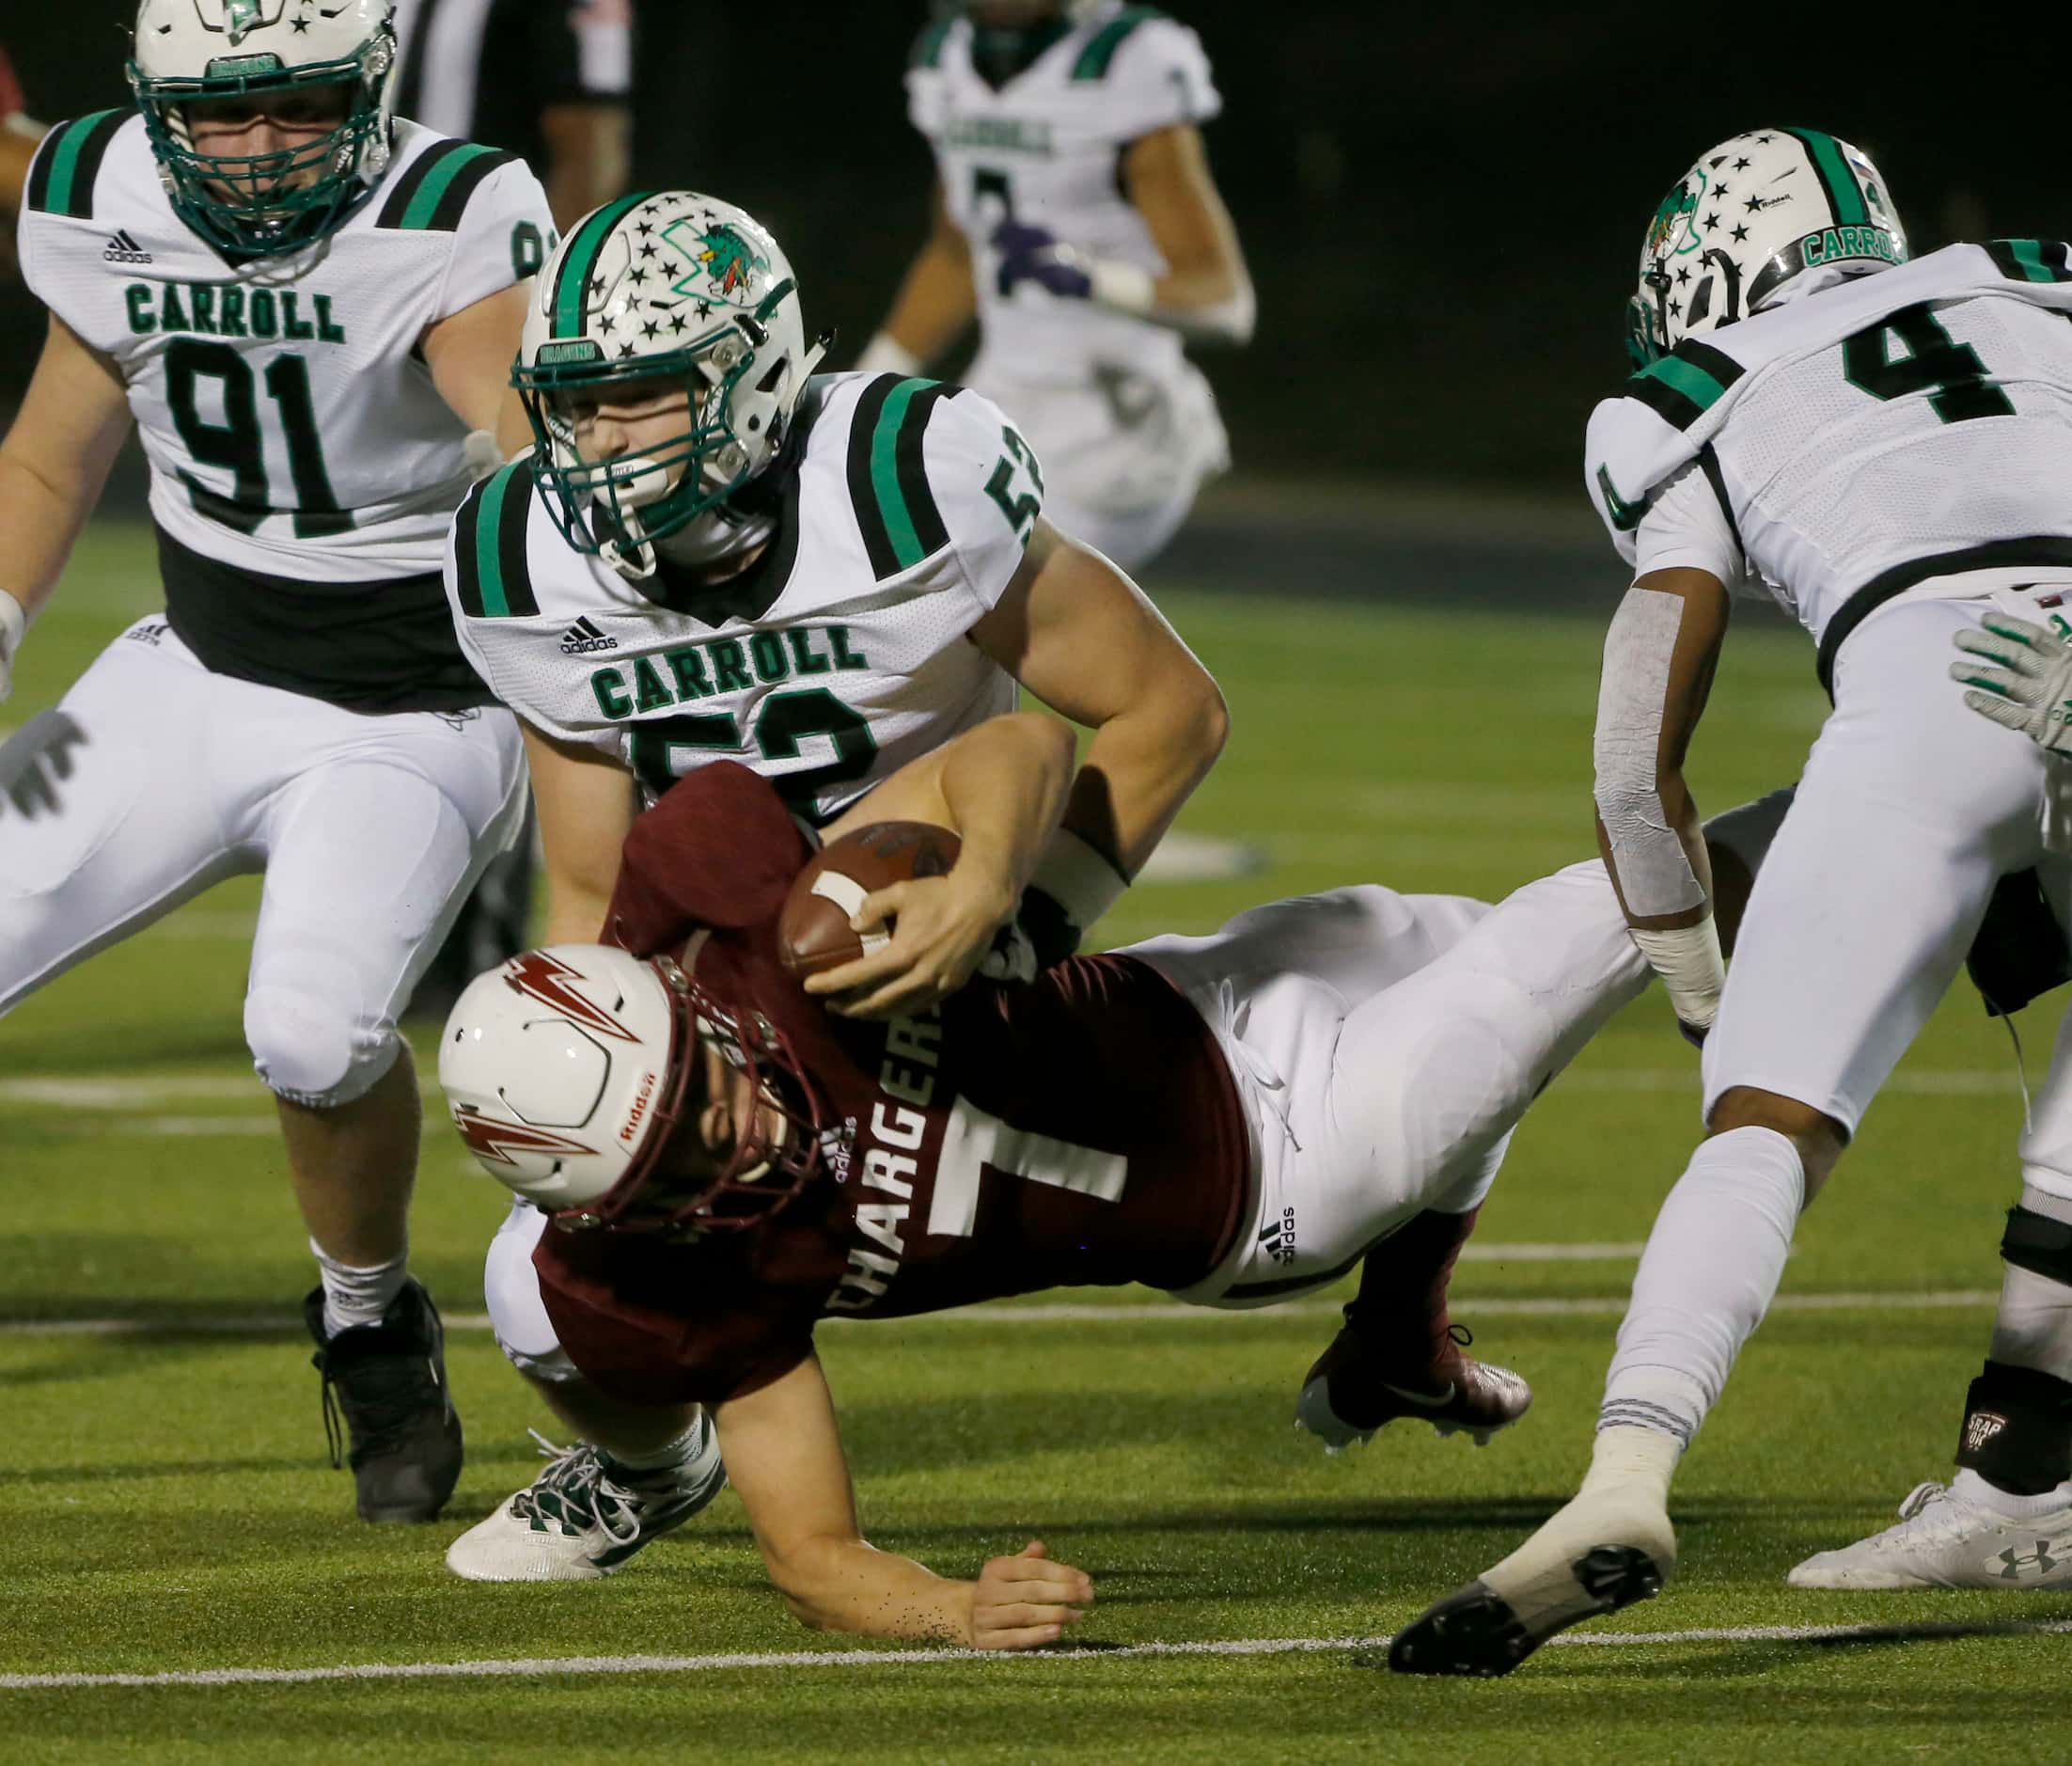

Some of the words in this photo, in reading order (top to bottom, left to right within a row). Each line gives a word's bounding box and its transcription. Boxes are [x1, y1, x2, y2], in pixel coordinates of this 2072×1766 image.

[103, 249, 153, 264] adidas
[126, 282, 346, 344] CARROLL
[1841, 299, 2017, 424] 4
[164, 335, 357, 539] 91
[560, 635, 618, 654] adidas
[590, 624, 871, 720] CARROLL
[630, 686, 880, 820] 52
[824, 1001, 944, 1310] CHARGER
[926, 1091, 1128, 1237] 7
